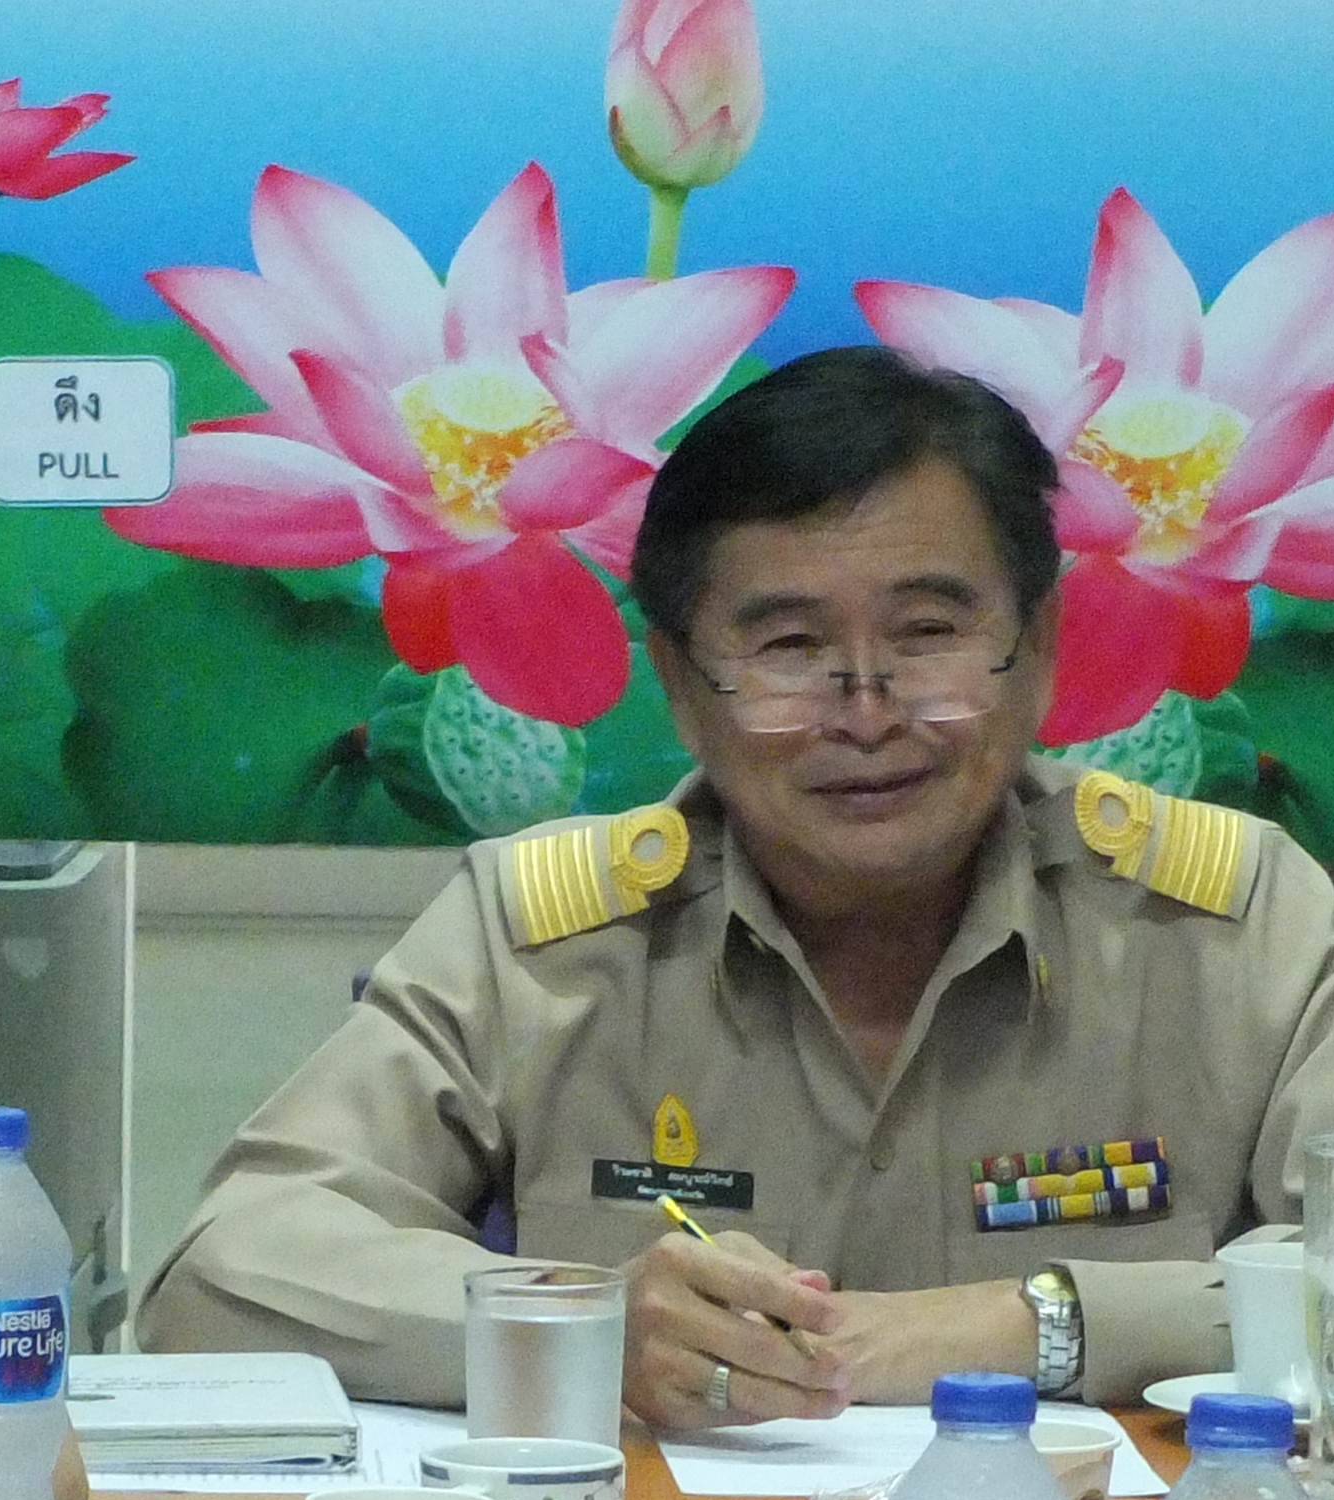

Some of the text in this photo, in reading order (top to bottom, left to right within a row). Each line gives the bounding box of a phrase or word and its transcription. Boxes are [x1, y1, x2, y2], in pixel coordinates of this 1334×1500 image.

[54, 375, 100, 422] ดึง
[38, 452, 120, 478] PULL
[36, 1328, 64, 1364] Life
